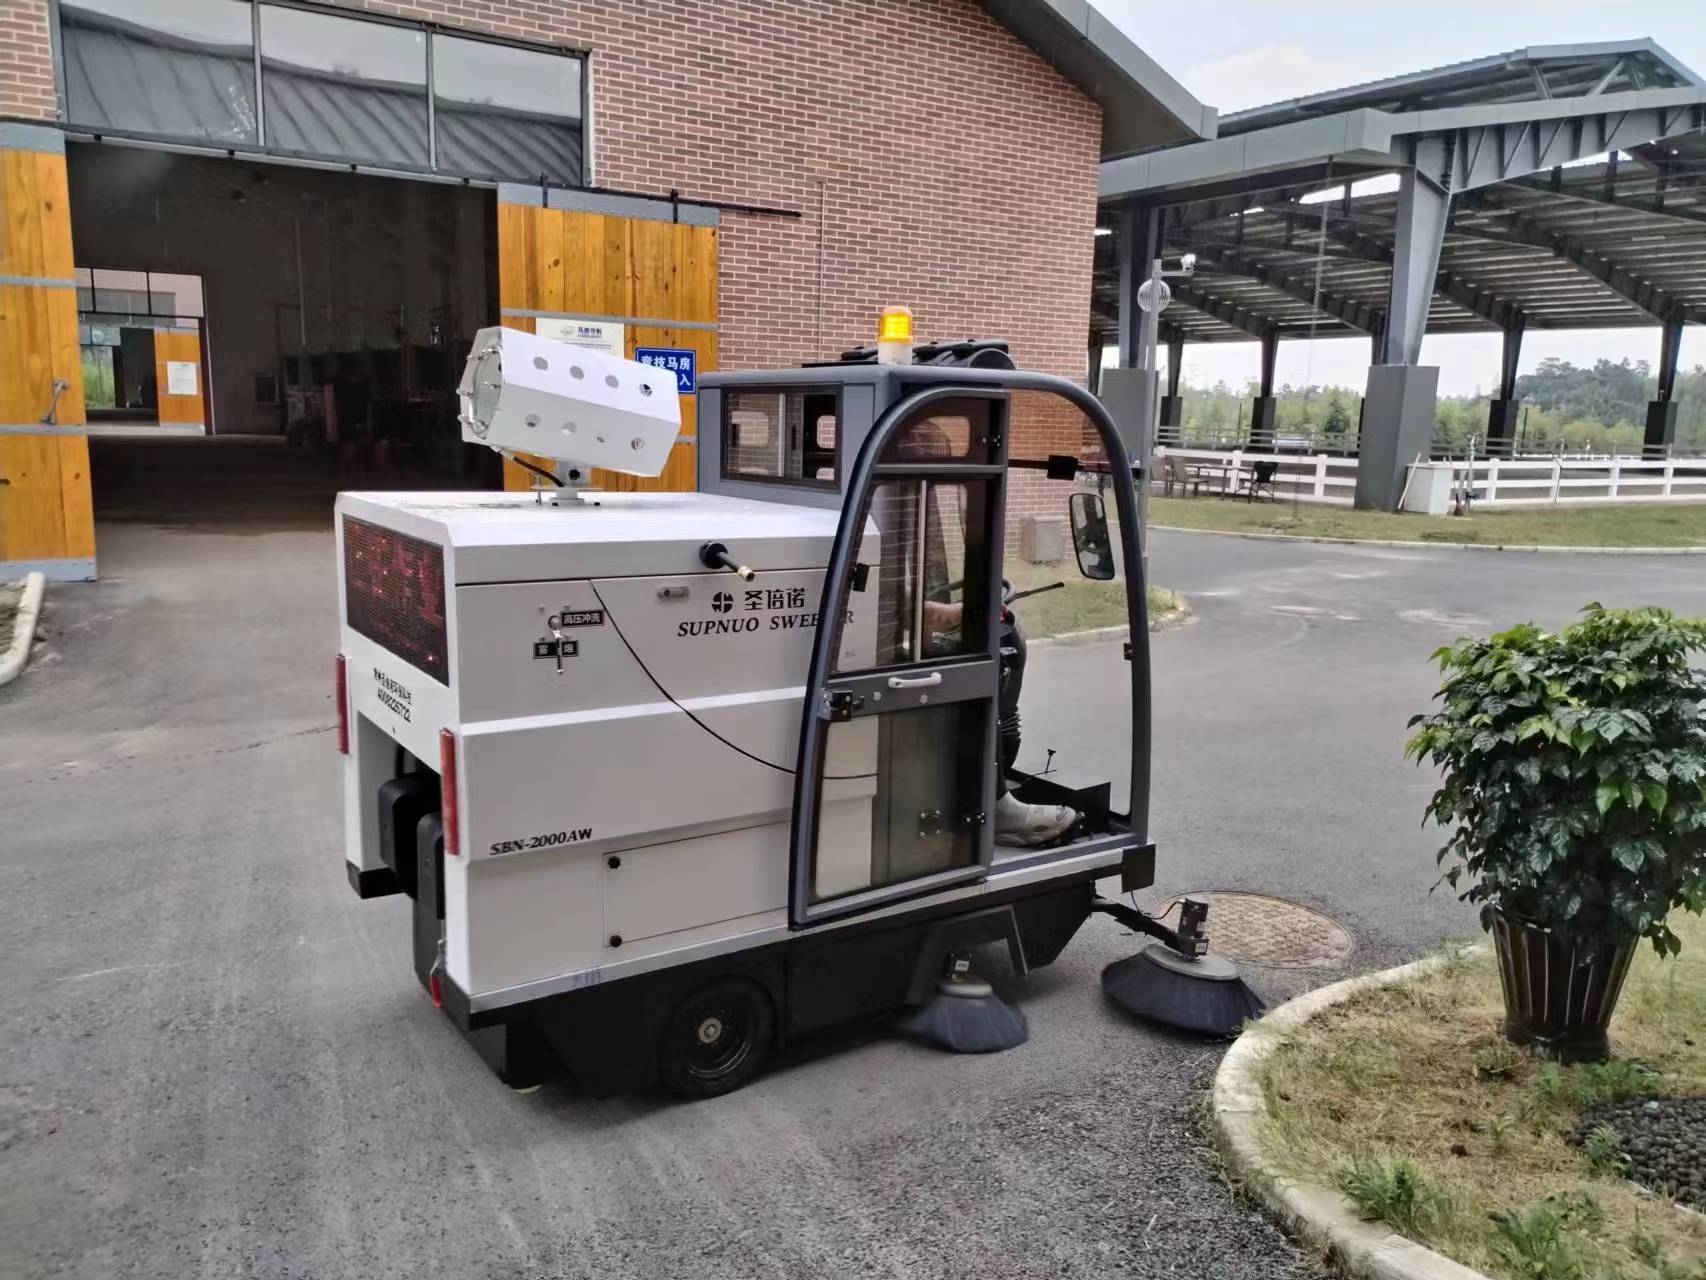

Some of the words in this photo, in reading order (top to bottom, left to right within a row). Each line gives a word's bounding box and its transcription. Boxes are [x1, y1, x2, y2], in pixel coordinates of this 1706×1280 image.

[680, 373, 691, 386] 入
[744, 587, 806, 611] 圣倍诺
[563, 612, 601, 625] 高压冲洗
[677, 617, 760, 637] SUPNUO
[769, 610, 854, 631] SWEER
[489, 827, 593, 856] SBN-2000AW
